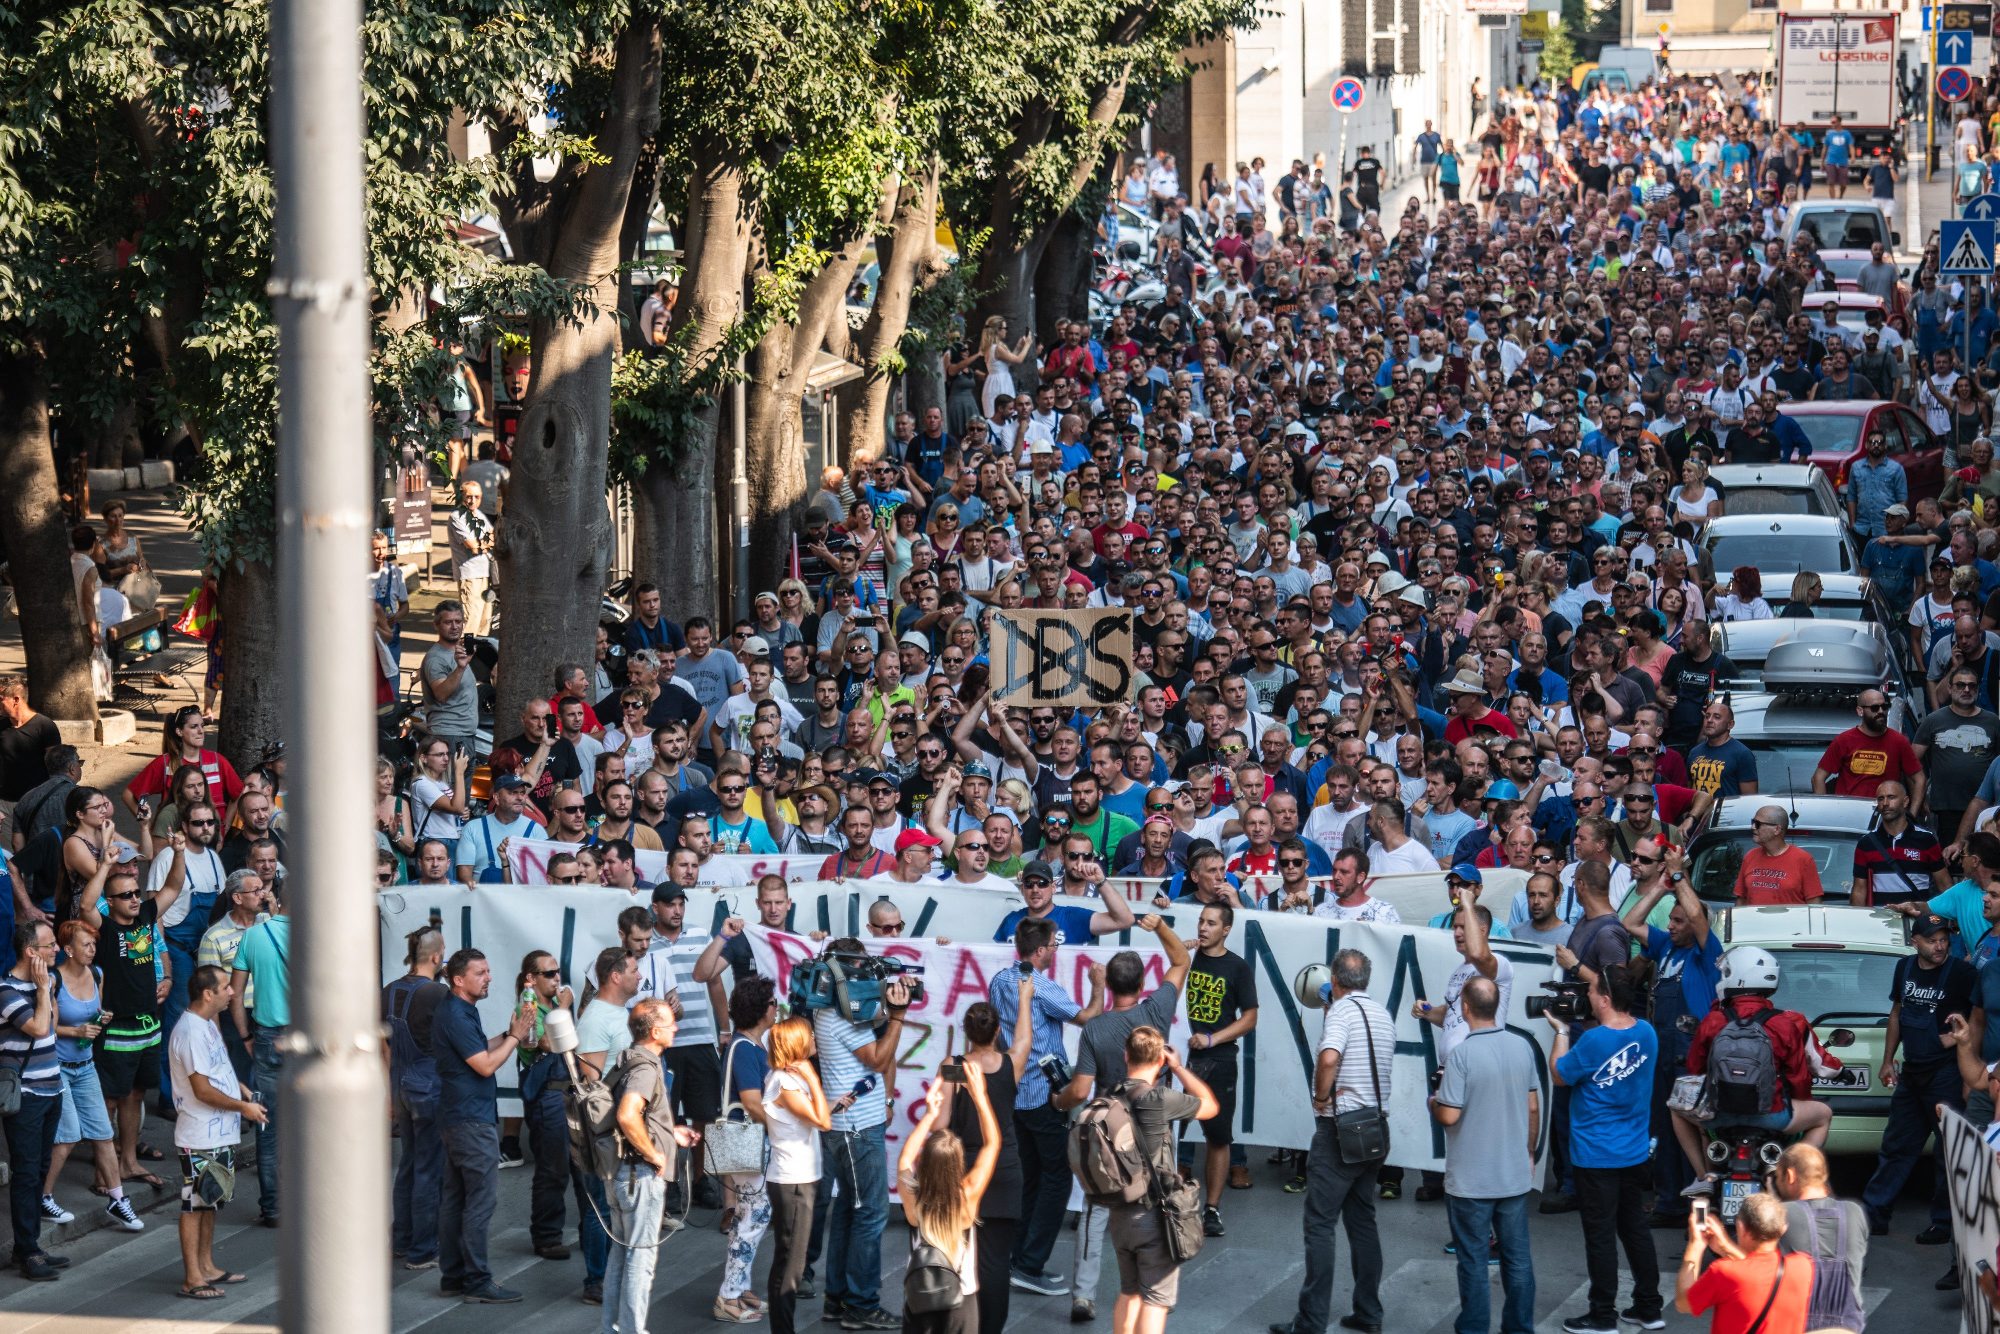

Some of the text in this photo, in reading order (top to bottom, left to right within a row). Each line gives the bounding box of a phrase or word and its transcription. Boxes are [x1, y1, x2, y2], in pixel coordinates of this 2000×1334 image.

[1944, 10, 1970, 28] 65
[1790, 28, 1859, 49] RALU
[1053, 794, 1072, 802] PUM
[118, 932, 128, 957] PARIS
[1189, 971, 1226, 995] ULA
[1201, 994, 1222, 1009] JE
[1188, 1005, 1221, 1023] AJ
[1597, 1054, 1648, 1089] TV NOVA
[1732, 1184, 1745, 1197] DS
